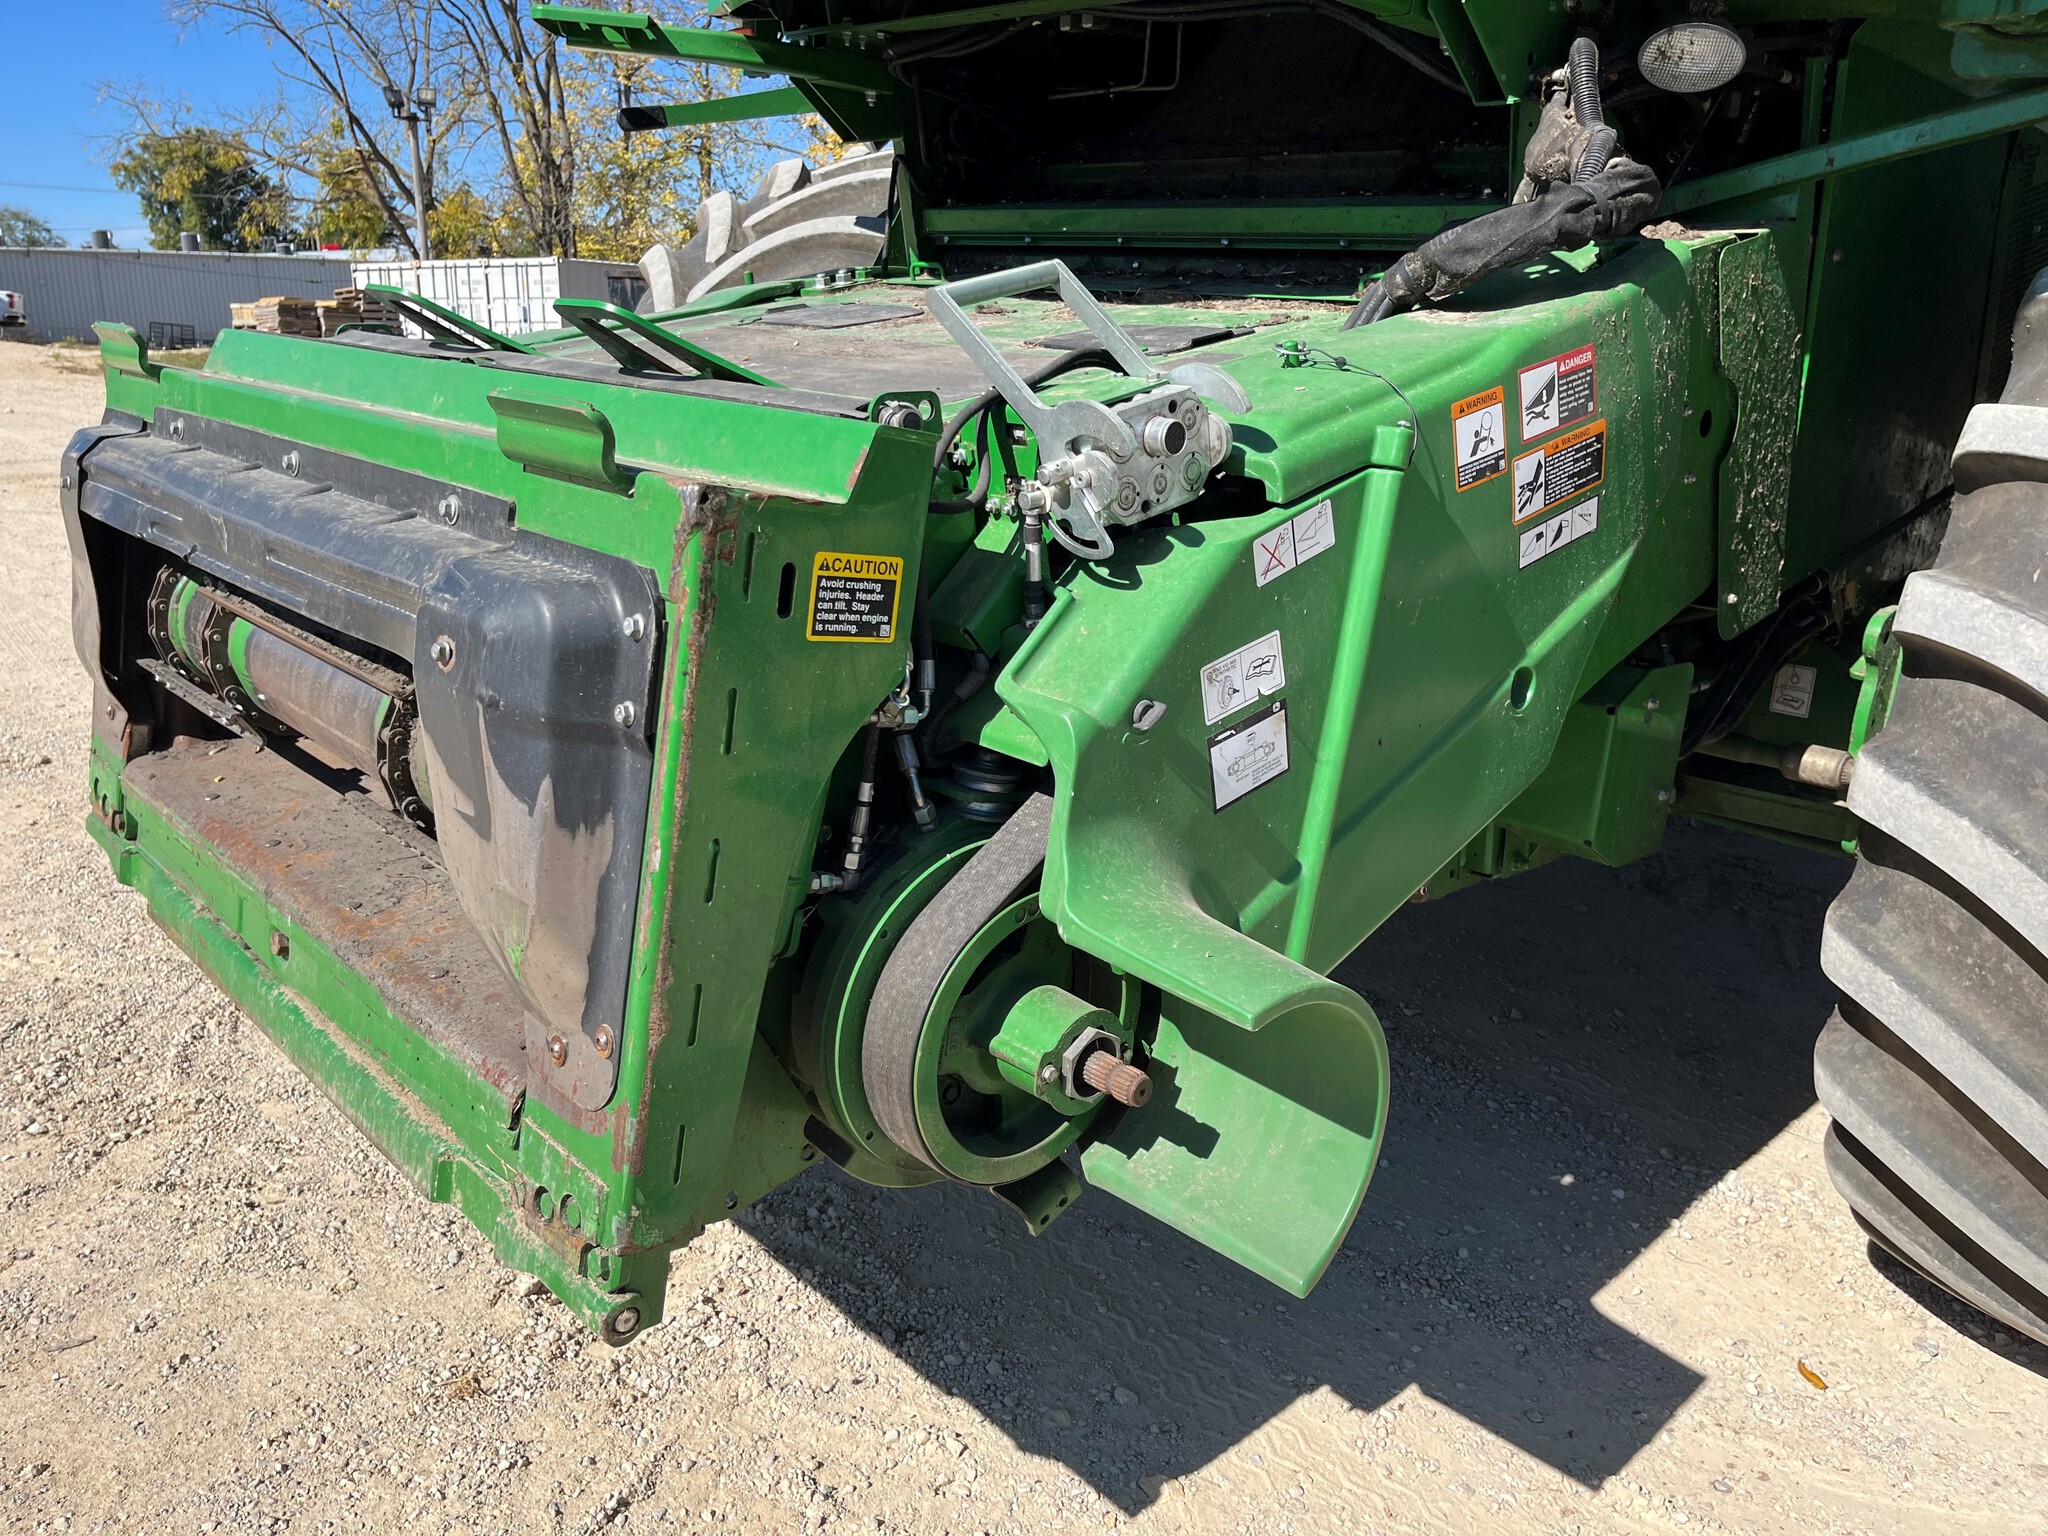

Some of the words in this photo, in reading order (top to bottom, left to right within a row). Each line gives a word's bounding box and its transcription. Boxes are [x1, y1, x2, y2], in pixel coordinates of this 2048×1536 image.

[1565, 351, 1592, 370] DANGER
[1466, 391, 1497, 410] WARNING
[1562, 428, 1591, 446] WARNING
[832, 558, 899, 576] CAUTION
[820, 578, 844, 588] Avoid
[846, 580, 881, 592] crushing
[819, 590, 851, 600] injuries.
[856, 591, 884, 601] Header
[817, 602, 832, 610] can
[834, 601, 847, 610] tilt.
[852, 601, 870, 613] Stay
[816, 611, 837, 620] clear
[839, 612, 860, 621] when
[862, 614, 889, 624] engine
[815, 622, 823, 631] is
[825, 623, 858, 634] running.
